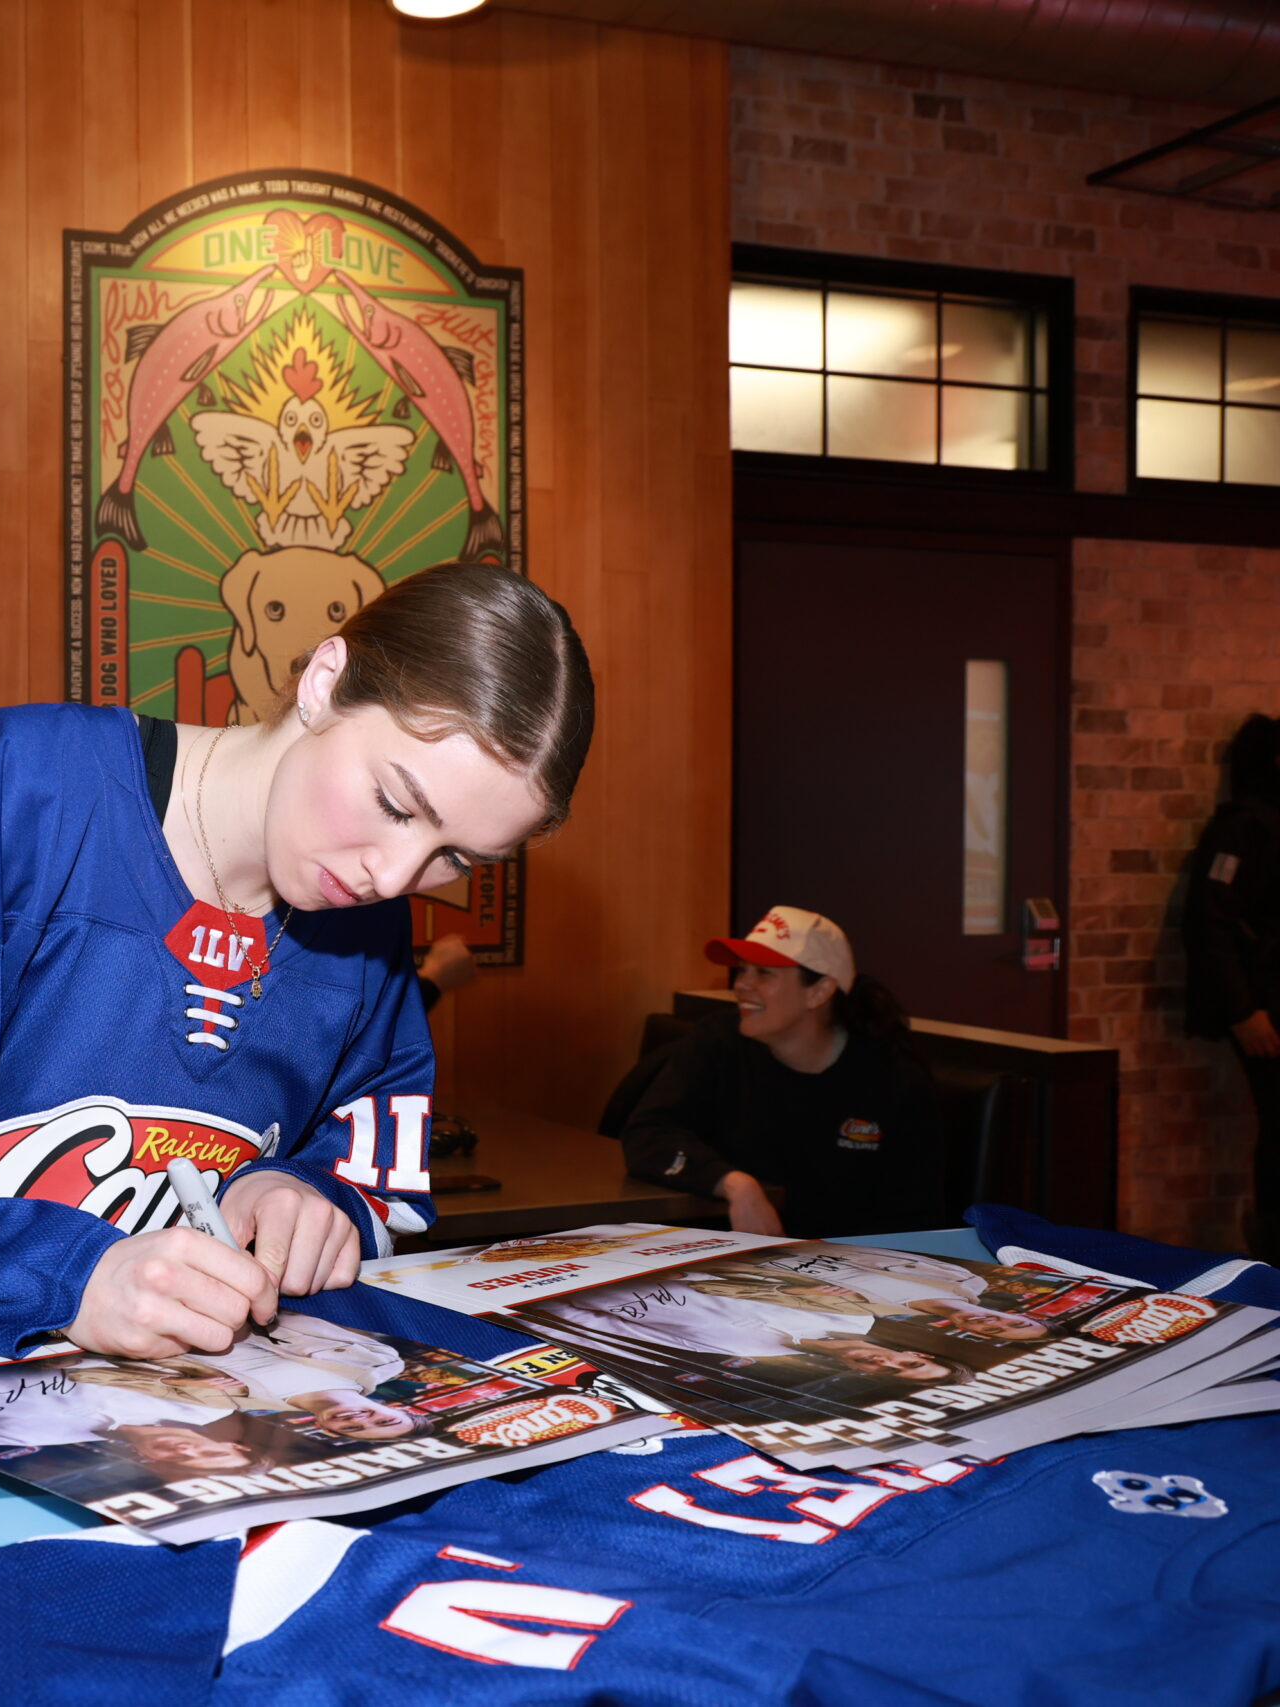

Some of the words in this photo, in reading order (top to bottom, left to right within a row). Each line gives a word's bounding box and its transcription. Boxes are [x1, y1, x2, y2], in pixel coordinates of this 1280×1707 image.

[148, 219, 166, 236] ALL
[71, 241, 82, 302] RESTAURANT
[203, 226, 279, 268] ONE
[322, 229, 406, 285] LOVE
[71, 303, 82, 323] OWN
[102, 280, 215, 364] fish
[71, 342, 82, 378] OPENING
[71, 392, 82, 421] DREAM
[71, 441, 82, 462] MAKE
[71, 463, 82, 475] TO
[71, 478, 82, 506] MONEY
[71, 507, 82, 541] ENOUGH
[71, 543, 82, 562] HAD
[100, 558, 117, 611] LOVED
[100, 617, 117, 656] WHO
[71, 649, 82, 700] ADVENTURE
[100, 662, 117, 697] DOG
[188, 925, 254, 972] 1LV
[135, 1127, 241, 1173] Raising
[467, 1262, 590, 1291] HUGHES
[1110, 1293, 1218, 1345] Cane's
[909, 1337, 1127, 1411] RAISING
[478, 1394, 614, 1448] Cane's
[163, 1437, 475, 1503] RAISING
